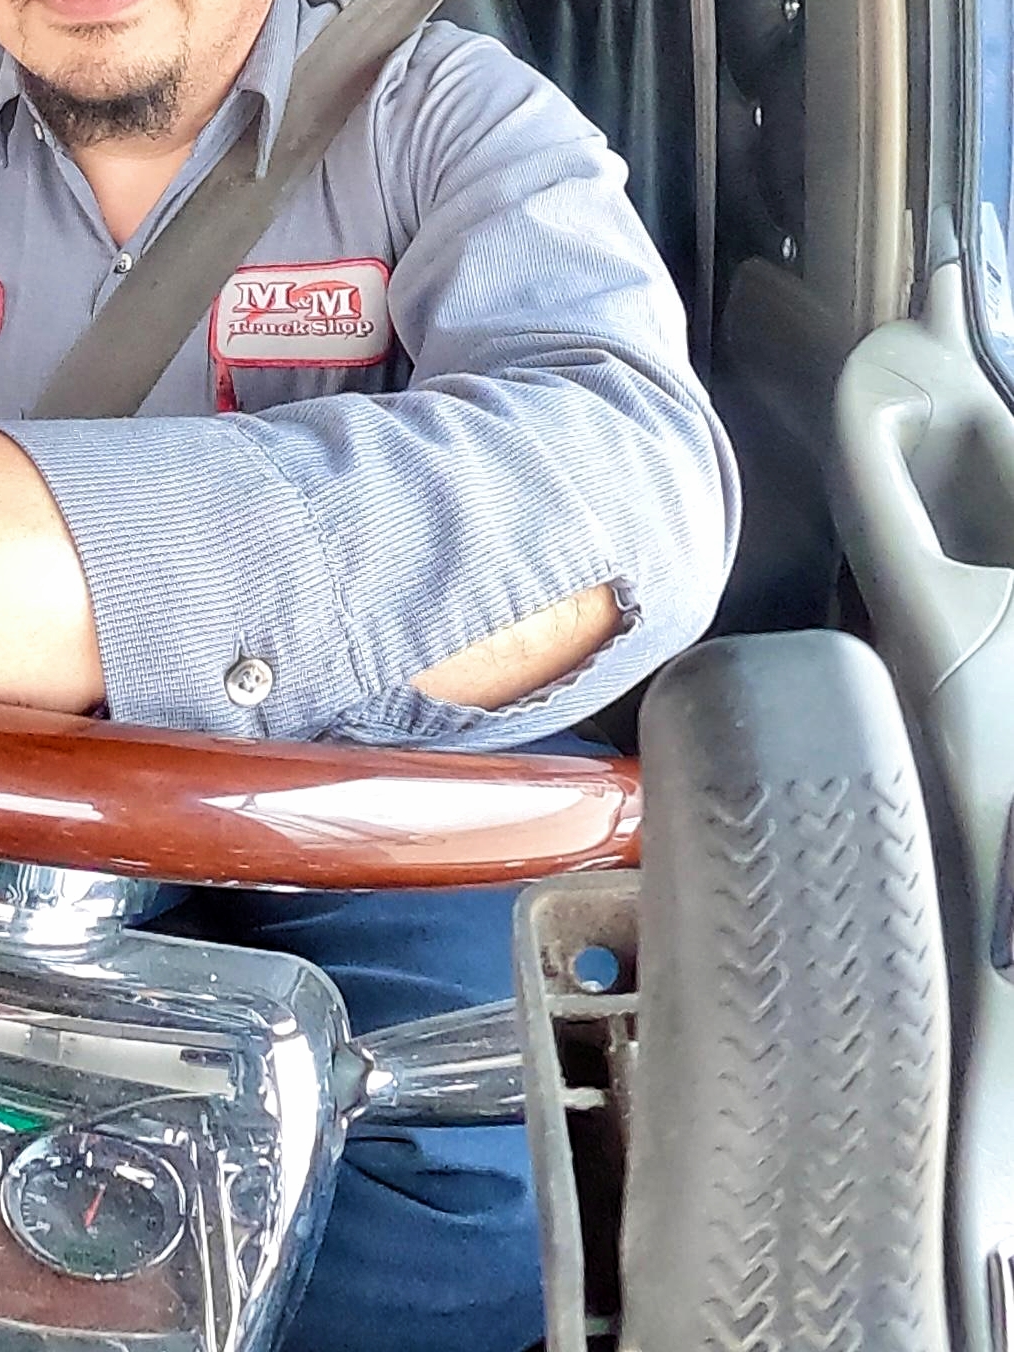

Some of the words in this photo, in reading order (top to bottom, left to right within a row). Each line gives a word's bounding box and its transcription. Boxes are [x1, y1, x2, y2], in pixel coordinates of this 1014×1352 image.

[233, 281, 362, 320] M&M
[228, 320, 309, 340] Truck
[310, 319, 374, 338] Shop
